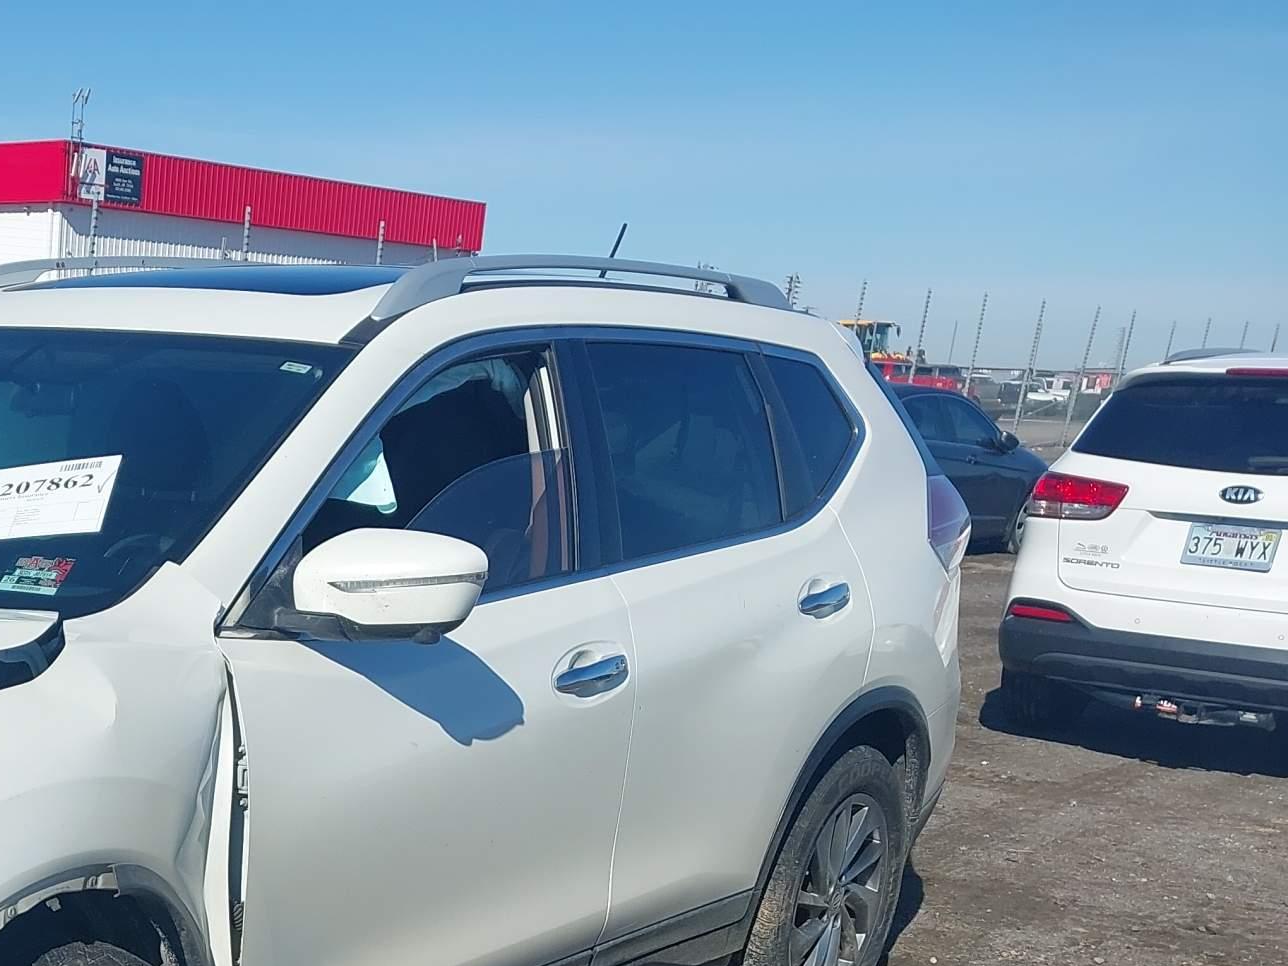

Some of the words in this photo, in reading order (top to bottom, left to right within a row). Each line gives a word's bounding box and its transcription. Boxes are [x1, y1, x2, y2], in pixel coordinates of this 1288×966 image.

[1225, 487, 1255, 501] KIA
[1188, 536, 1224, 556] 375
[1235, 540, 1271, 561] WYX
[1063, 557, 1120, 569] SORENTO
